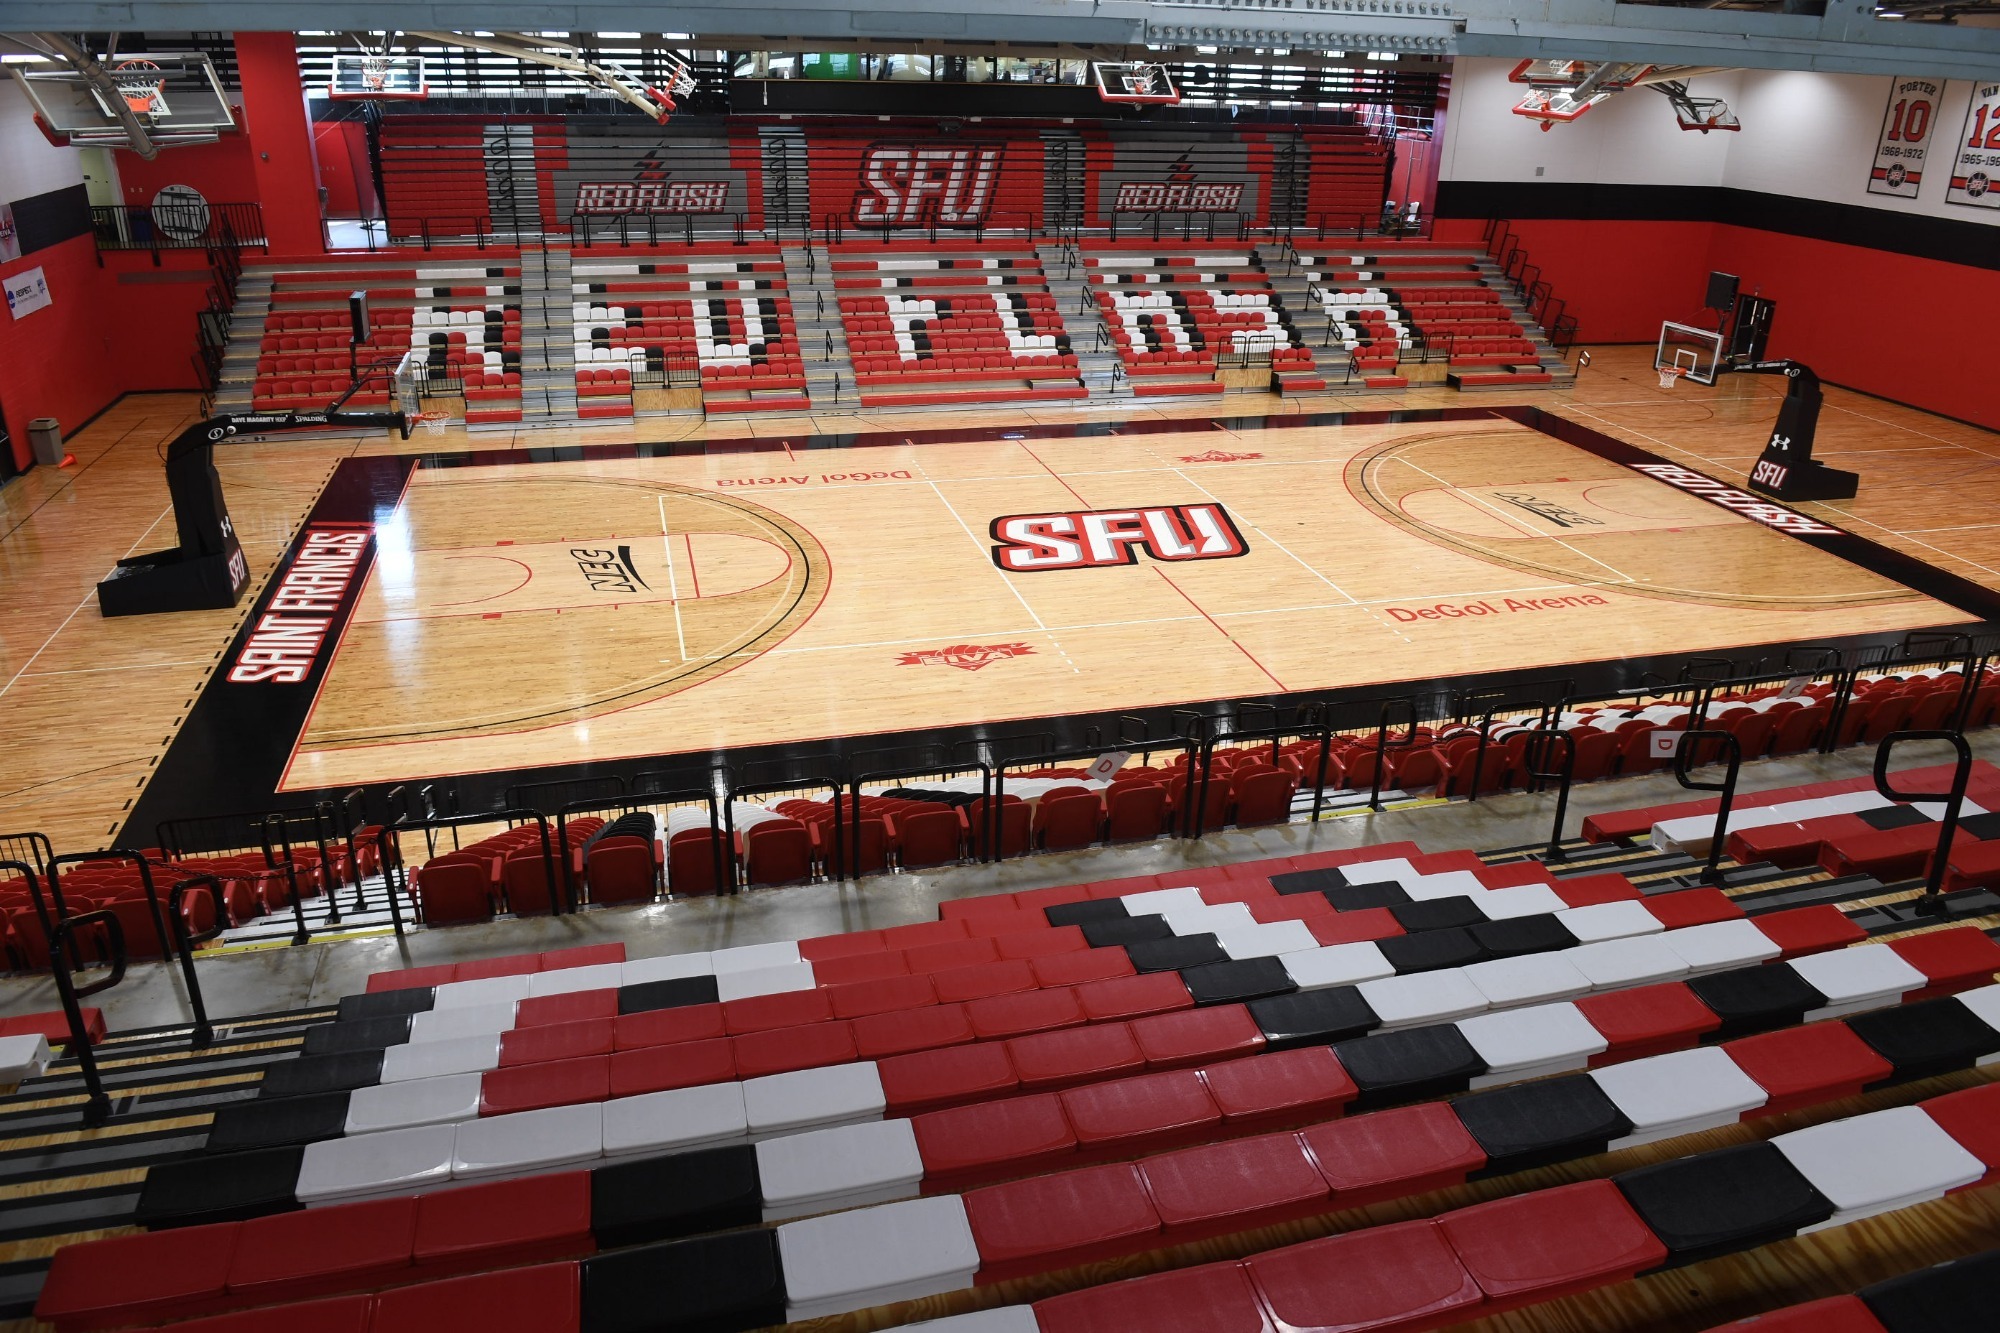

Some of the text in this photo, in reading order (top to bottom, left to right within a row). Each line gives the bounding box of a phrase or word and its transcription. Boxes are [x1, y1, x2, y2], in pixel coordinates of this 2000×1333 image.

[1900, 81, 1937, 96] PORTER
[1981, 85, 2000, 98] VAN
[1888, 99, 1932, 143] 10
[1881, 146, 1924, 159] 1968-1972
[576, 182, 730, 214] RED FLASH
[855, 146, 1001, 226] SFU
[1114, 183, 1243, 213] RED FLASH
[716, 470, 912, 487] DeGol Arena
[1753, 460, 1787, 488] SFU
[1628, 464, 1845, 535] RED FLASH
[998, 504, 1241, 569] SFU
[229, 549, 245, 591] SFU
[228, 533, 369, 682] SAINT FRANCIS
[1385, 595, 1609, 622] DeGol Arena
[919, 648, 1014, 666] EIVA
[1097, 759, 1113, 773] D
